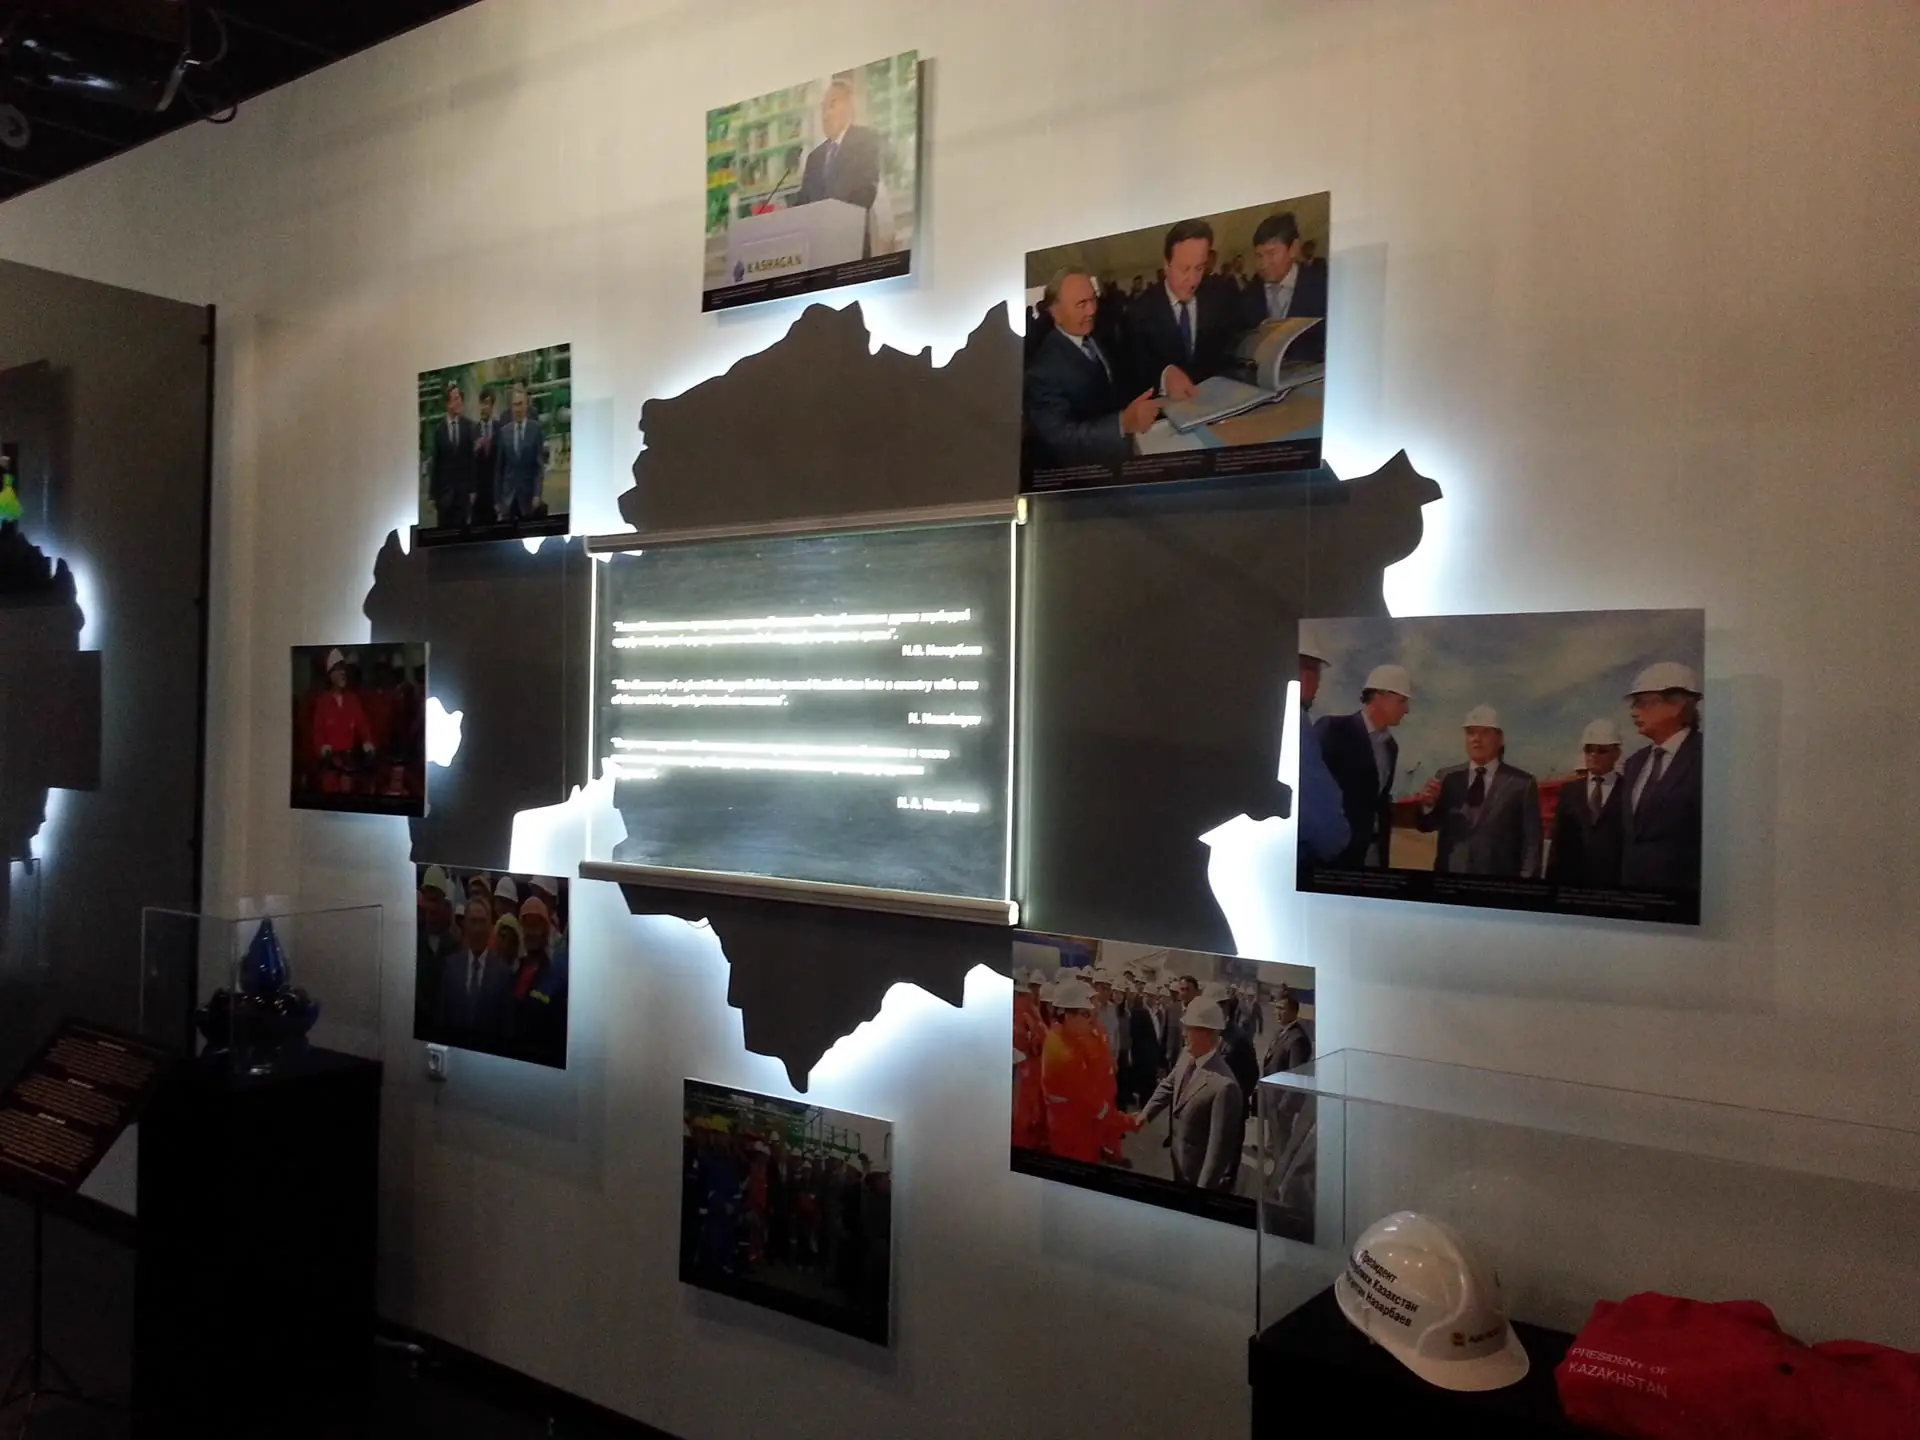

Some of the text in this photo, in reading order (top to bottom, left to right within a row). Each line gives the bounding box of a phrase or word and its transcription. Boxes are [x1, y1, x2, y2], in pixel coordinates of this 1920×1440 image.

[1571, 1346, 1668, 1377] PRESIDENT OF
[1568, 1360, 1669, 1400] KAZAKHSTAN
